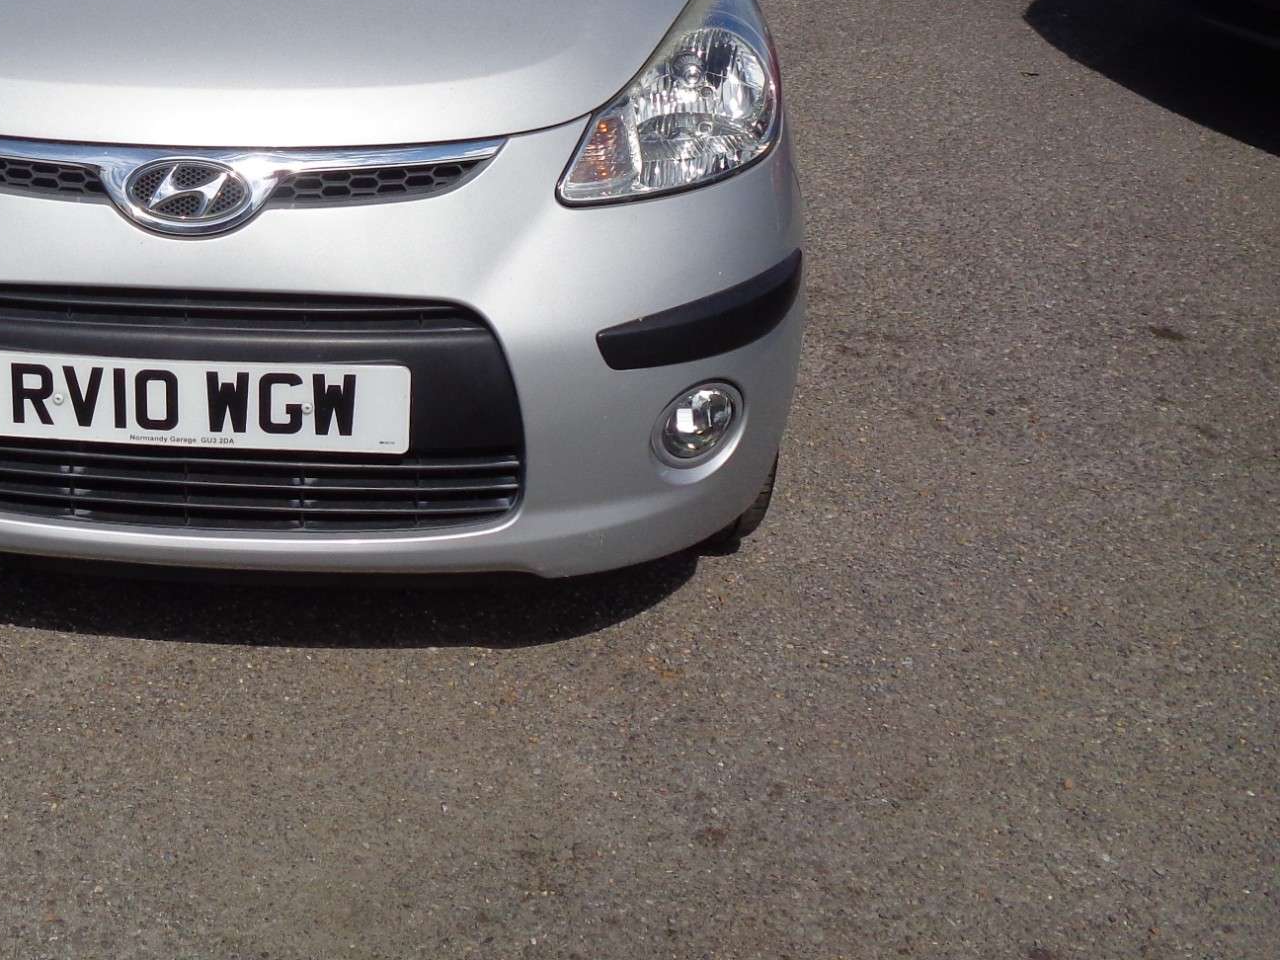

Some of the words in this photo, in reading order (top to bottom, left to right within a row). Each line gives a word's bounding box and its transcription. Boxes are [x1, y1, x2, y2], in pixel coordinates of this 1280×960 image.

[10, 361, 179, 431] RV10
[206, 370, 357, 437] WGW
[129, 434, 168, 444] Normandy
[169, 436, 197, 444] Garage
